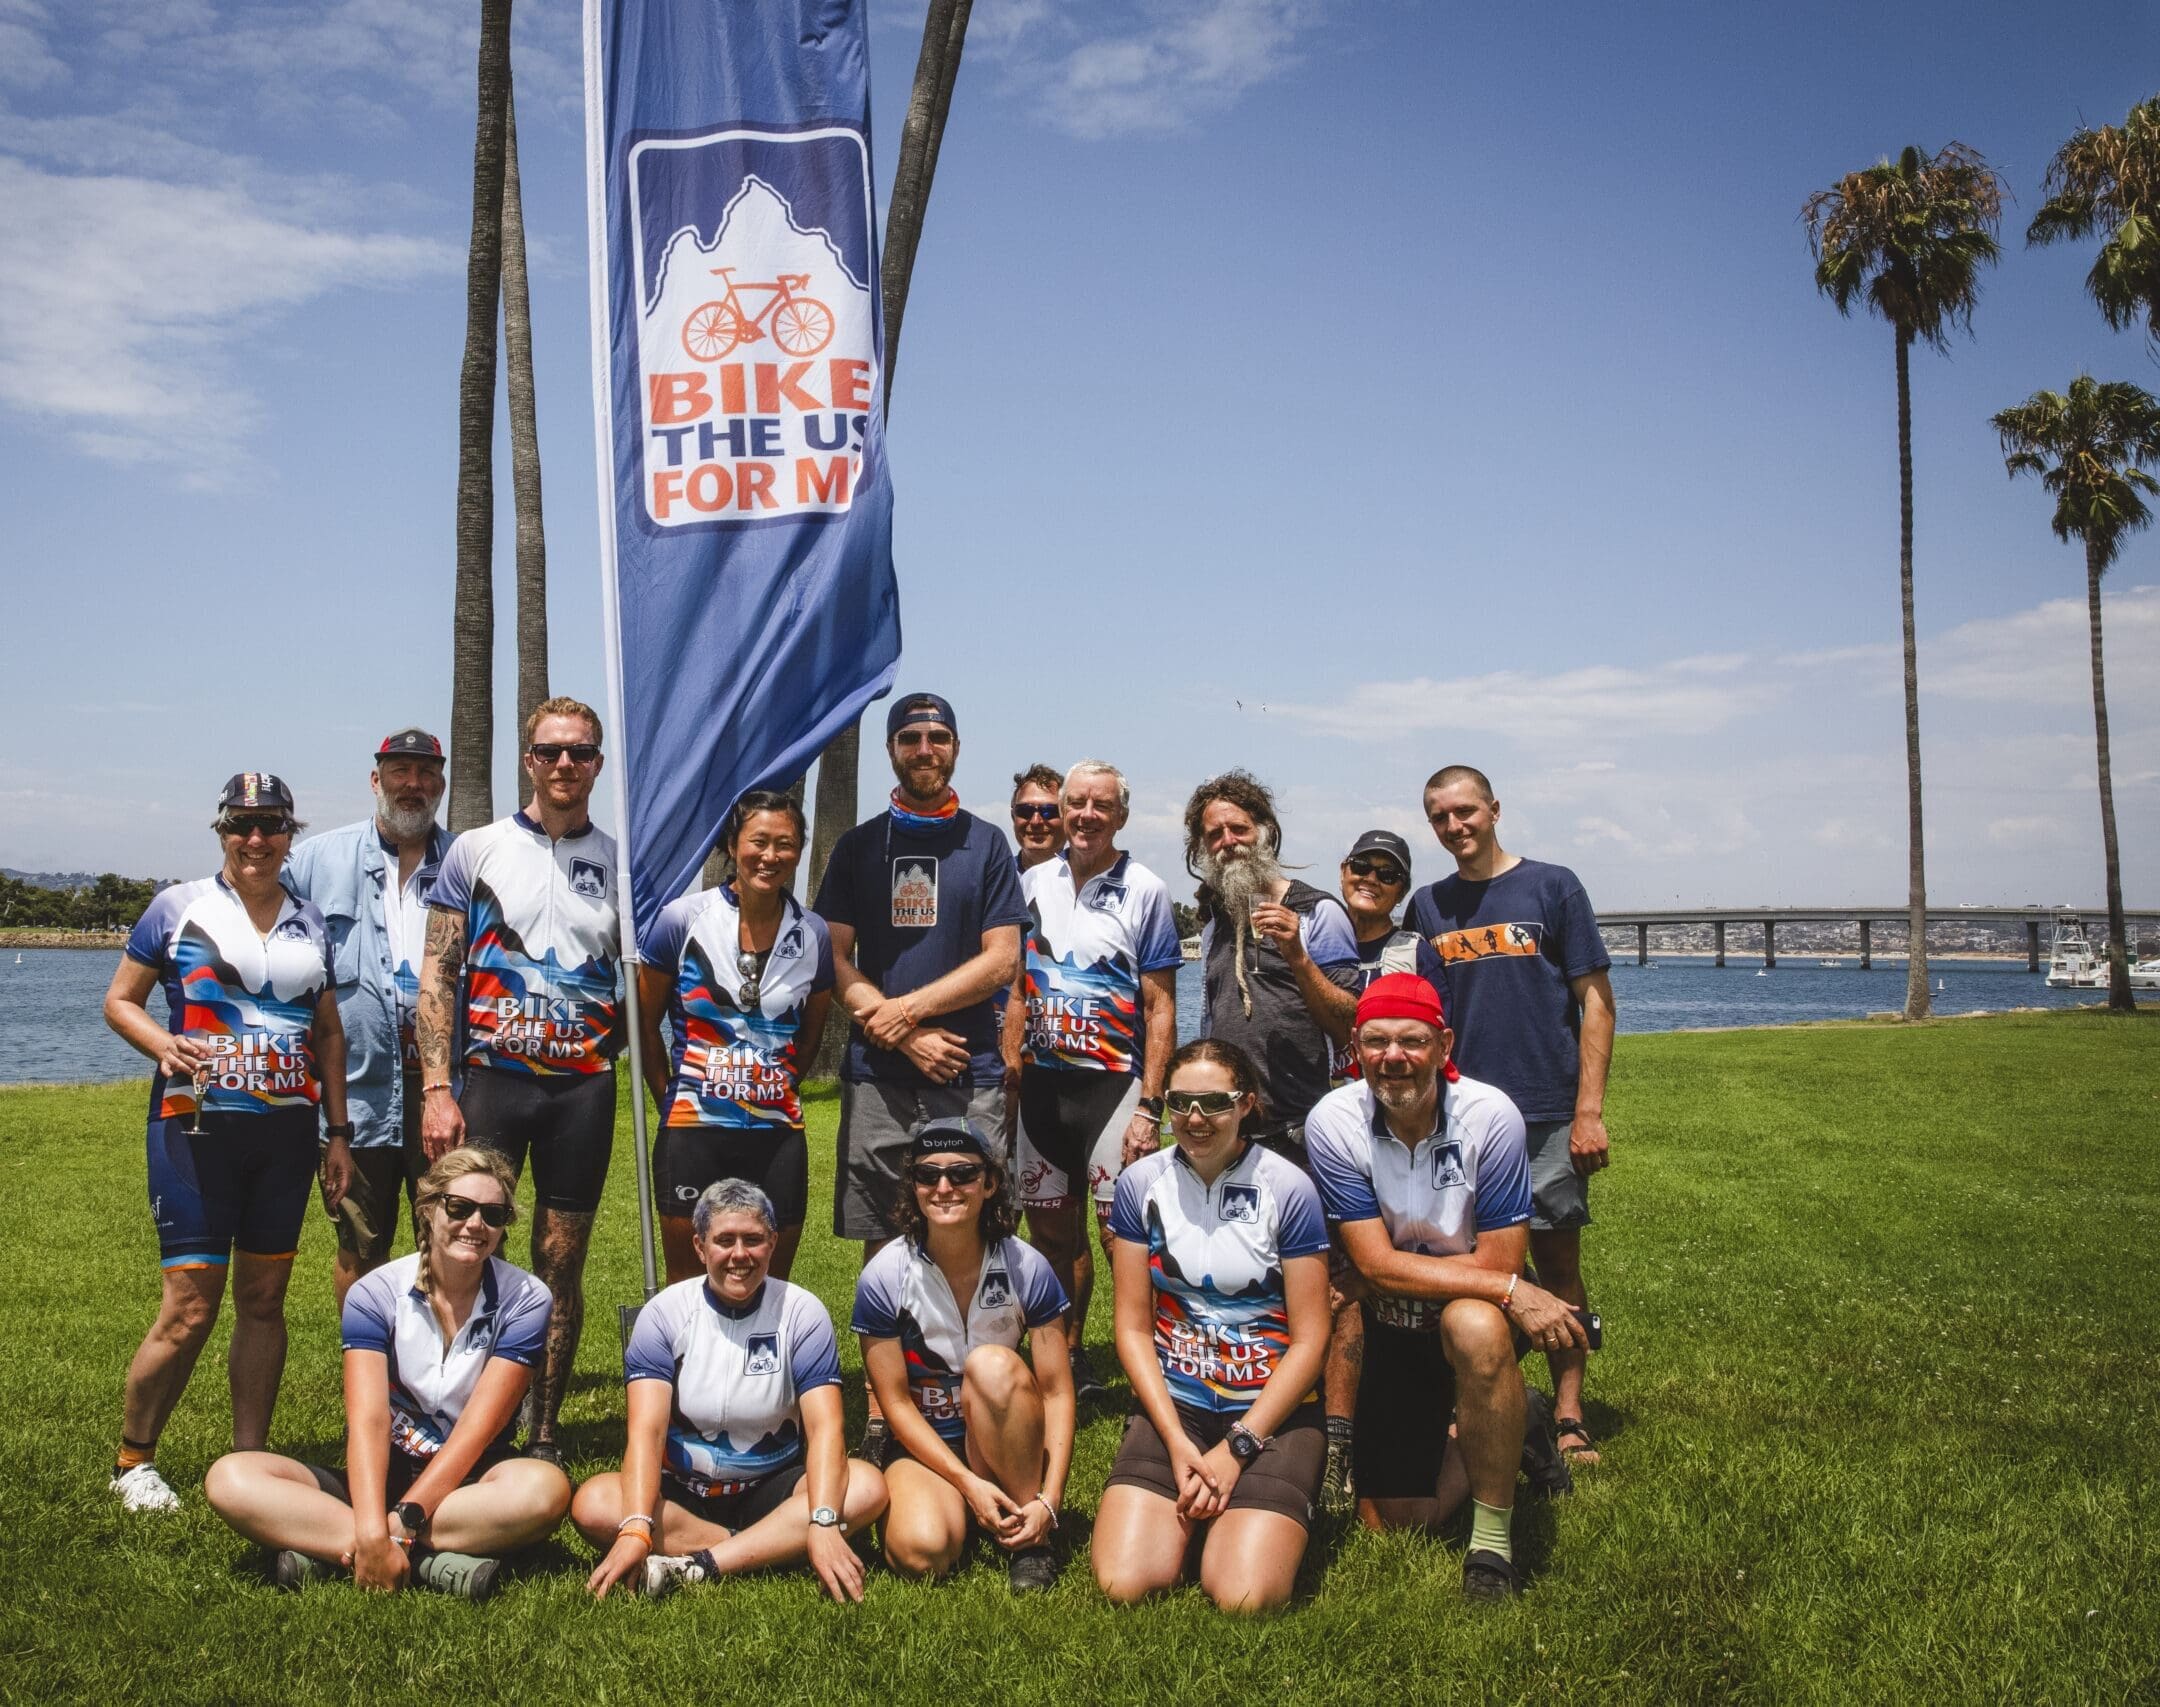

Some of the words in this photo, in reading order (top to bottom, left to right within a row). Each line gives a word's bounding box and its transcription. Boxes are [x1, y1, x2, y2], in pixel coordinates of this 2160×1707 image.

[648, 358, 871, 424] BIKE
[652, 418, 785, 466] THE
[654, 462, 780, 519] FOR
[795, 456, 861, 505] M
[894, 898, 936, 908] BIKE
[895, 908, 918, 916] THE
[921, 908, 936, 916] US
[894, 916, 916, 924] FOR
[919, 916, 936, 924] MS
[498, 996, 585, 1021] BIKE
[1031, 996, 1101, 1018] BIKE
[497, 1020, 547, 1038] THE
[555, 1023, 585, 1039] US
[1031, 1016, 1063, 1031] THE
[1070, 1019, 1100, 1033] US
[208, 1033, 304, 1055] BIKE
[490, 1035, 541, 1058] FOR
[548, 1040, 586, 1058] MS
[1029, 1032, 1059, 1049] FOR
[1065, 1034, 1101, 1051] MS
[207, 1055, 270, 1071] THE
[278, 1055, 305, 1070] US
[707, 1046, 782, 1066] BIKE
[274, 1070, 306, 1090] MS
[706, 1065, 754, 1082] THE
[761, 1067, 784, 1082] US
[701, 1080, 751, 1101] FOR
[756, 1083, 785, 1101] MS
[1172, 1320, 1265, 1346] BIKE
[1171, 1337, 1222, 1362] THE
[1230, 1342, 1269, 1362] US
[1166, 1350, 1218, 1381] FOR
[1225, 1359, 1273, 1382] MS
